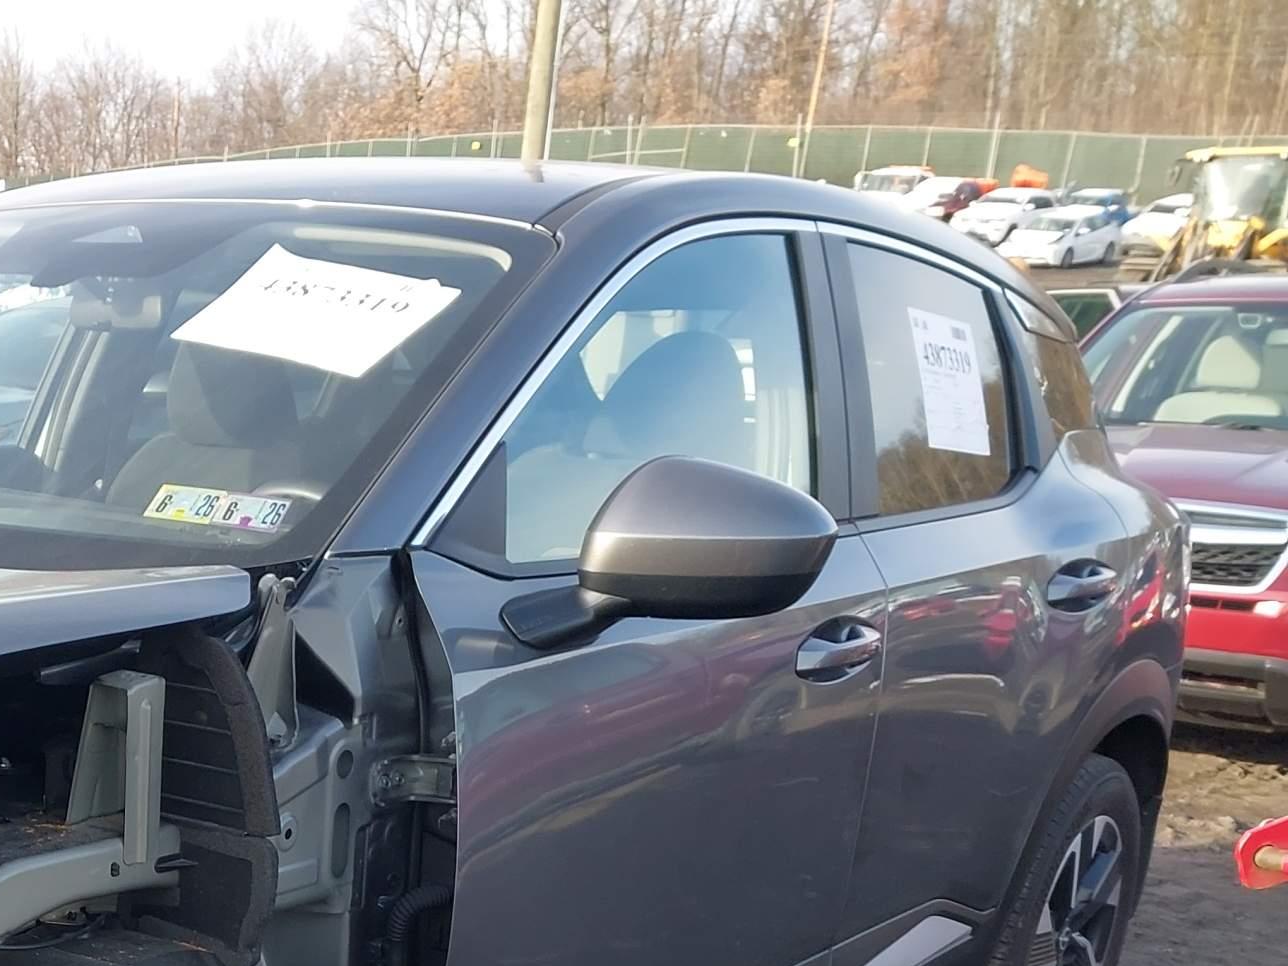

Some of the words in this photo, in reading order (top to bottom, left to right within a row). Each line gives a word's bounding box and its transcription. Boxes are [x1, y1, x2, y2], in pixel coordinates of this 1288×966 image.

[923, 341, 972, 375] 43873319
[155, 494, 173, 513] 6
[195, 494, 220, 517] 26
[222, 501, 239, 521] 6
[261, 502, 287, 526] 26
